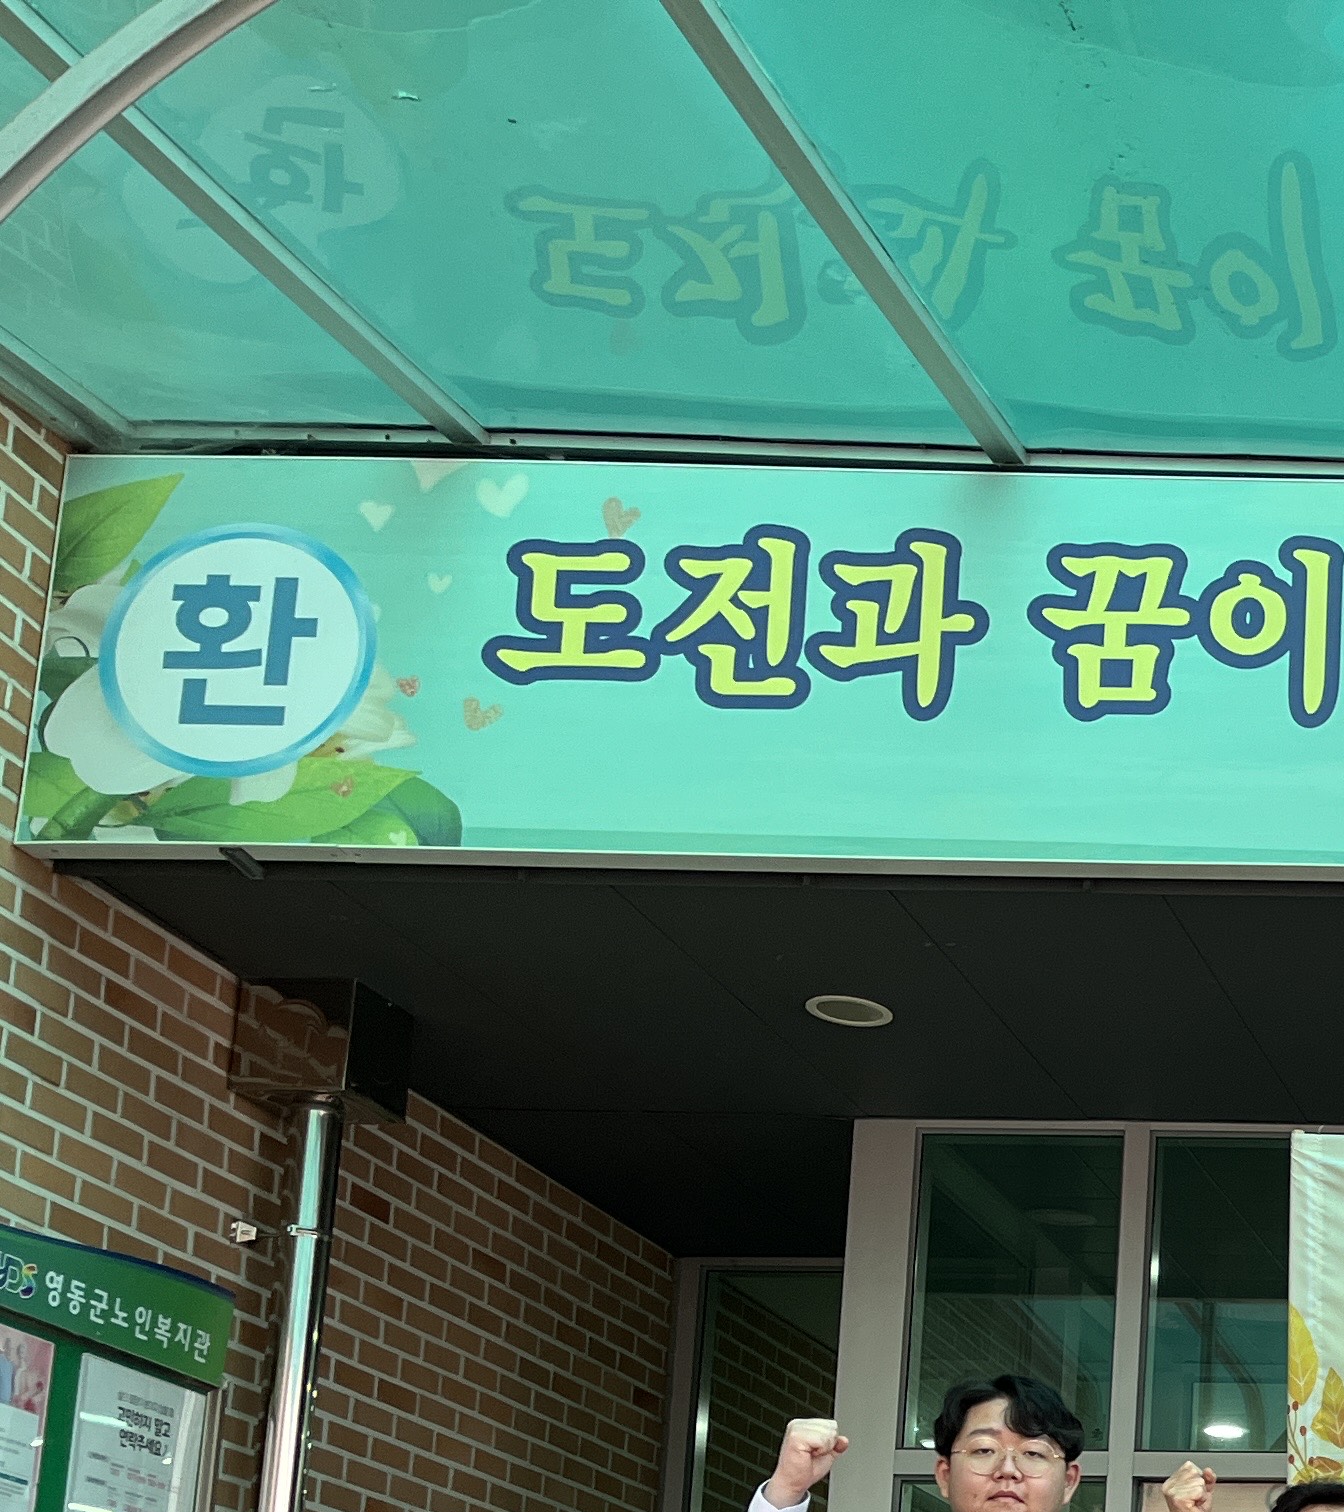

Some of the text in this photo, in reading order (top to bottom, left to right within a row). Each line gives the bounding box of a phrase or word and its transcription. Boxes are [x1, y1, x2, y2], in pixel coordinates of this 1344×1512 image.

[164, 575, 318, 726] 환
[482, 524, 990, 721] 도전과
[1027, 535, 1344, 728] 꿈이
[45, 1270, 211, 1364] 영동군노인복지관
